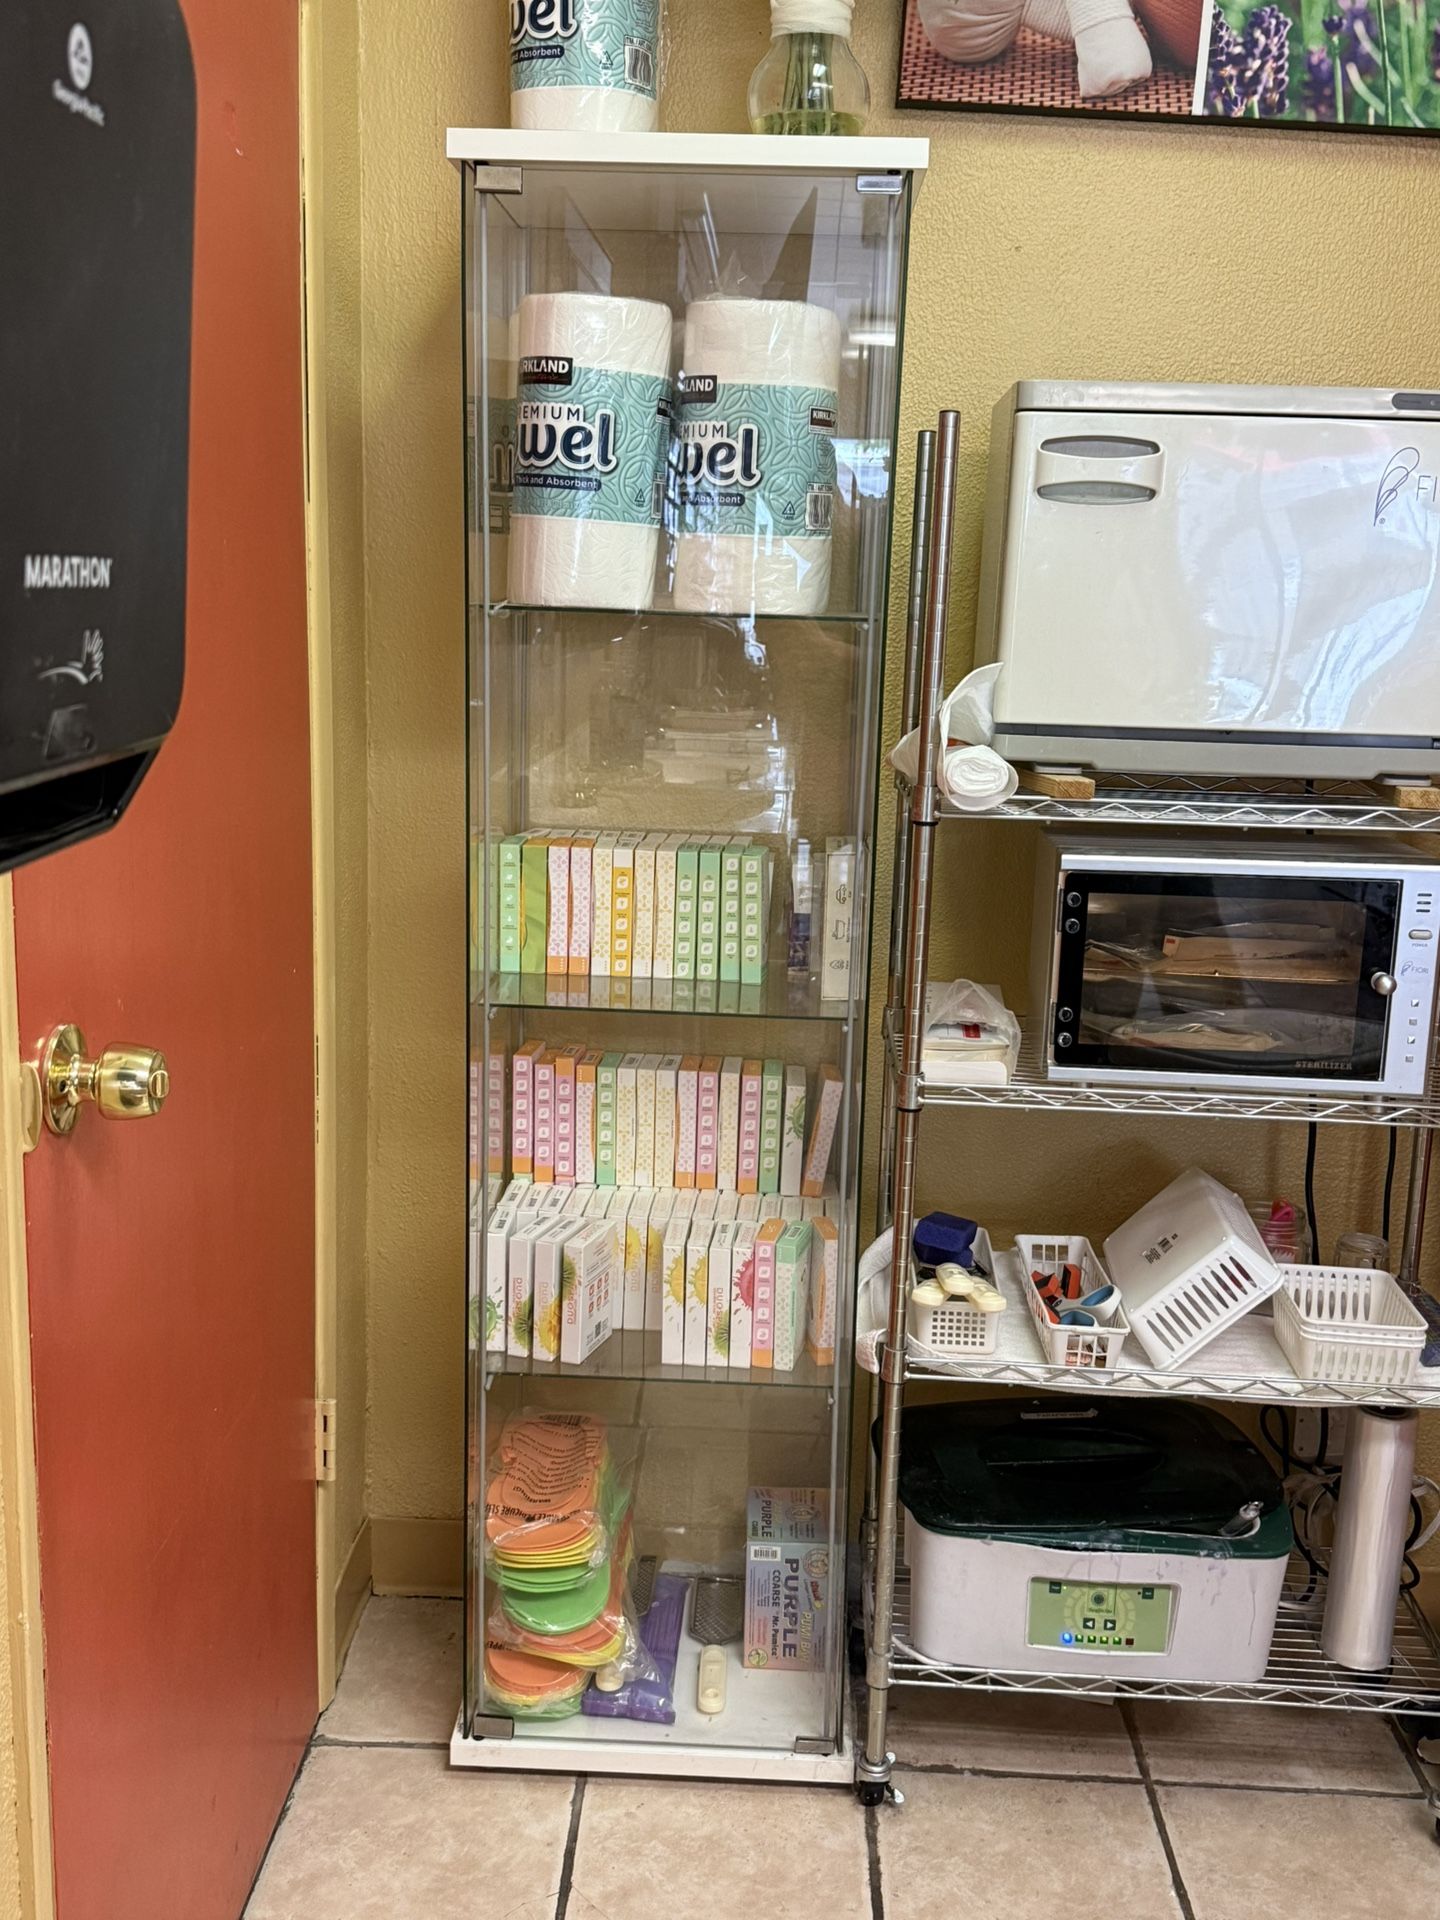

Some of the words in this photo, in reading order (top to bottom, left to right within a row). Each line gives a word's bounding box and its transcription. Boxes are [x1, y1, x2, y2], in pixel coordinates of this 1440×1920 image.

[520, 48, 561, 59] Absorbent
[520, 358, 569, 374] RKLAND
[682, 378, 714, 393] LAND
[519, 405, 581, 421] EMIUM
[530, 476, 544, 484] and
[546, 476, 598, 489] Absorbent
[24, 554, 111, 588] MARATHON
[1294, 1060, 1353, 1071] STERILIZER
[761, 1500, 772, 1537] PURPLE
[771, 1569, 781, 1607] COARSE
[782, 1558, 800, 1658] PURPLE
